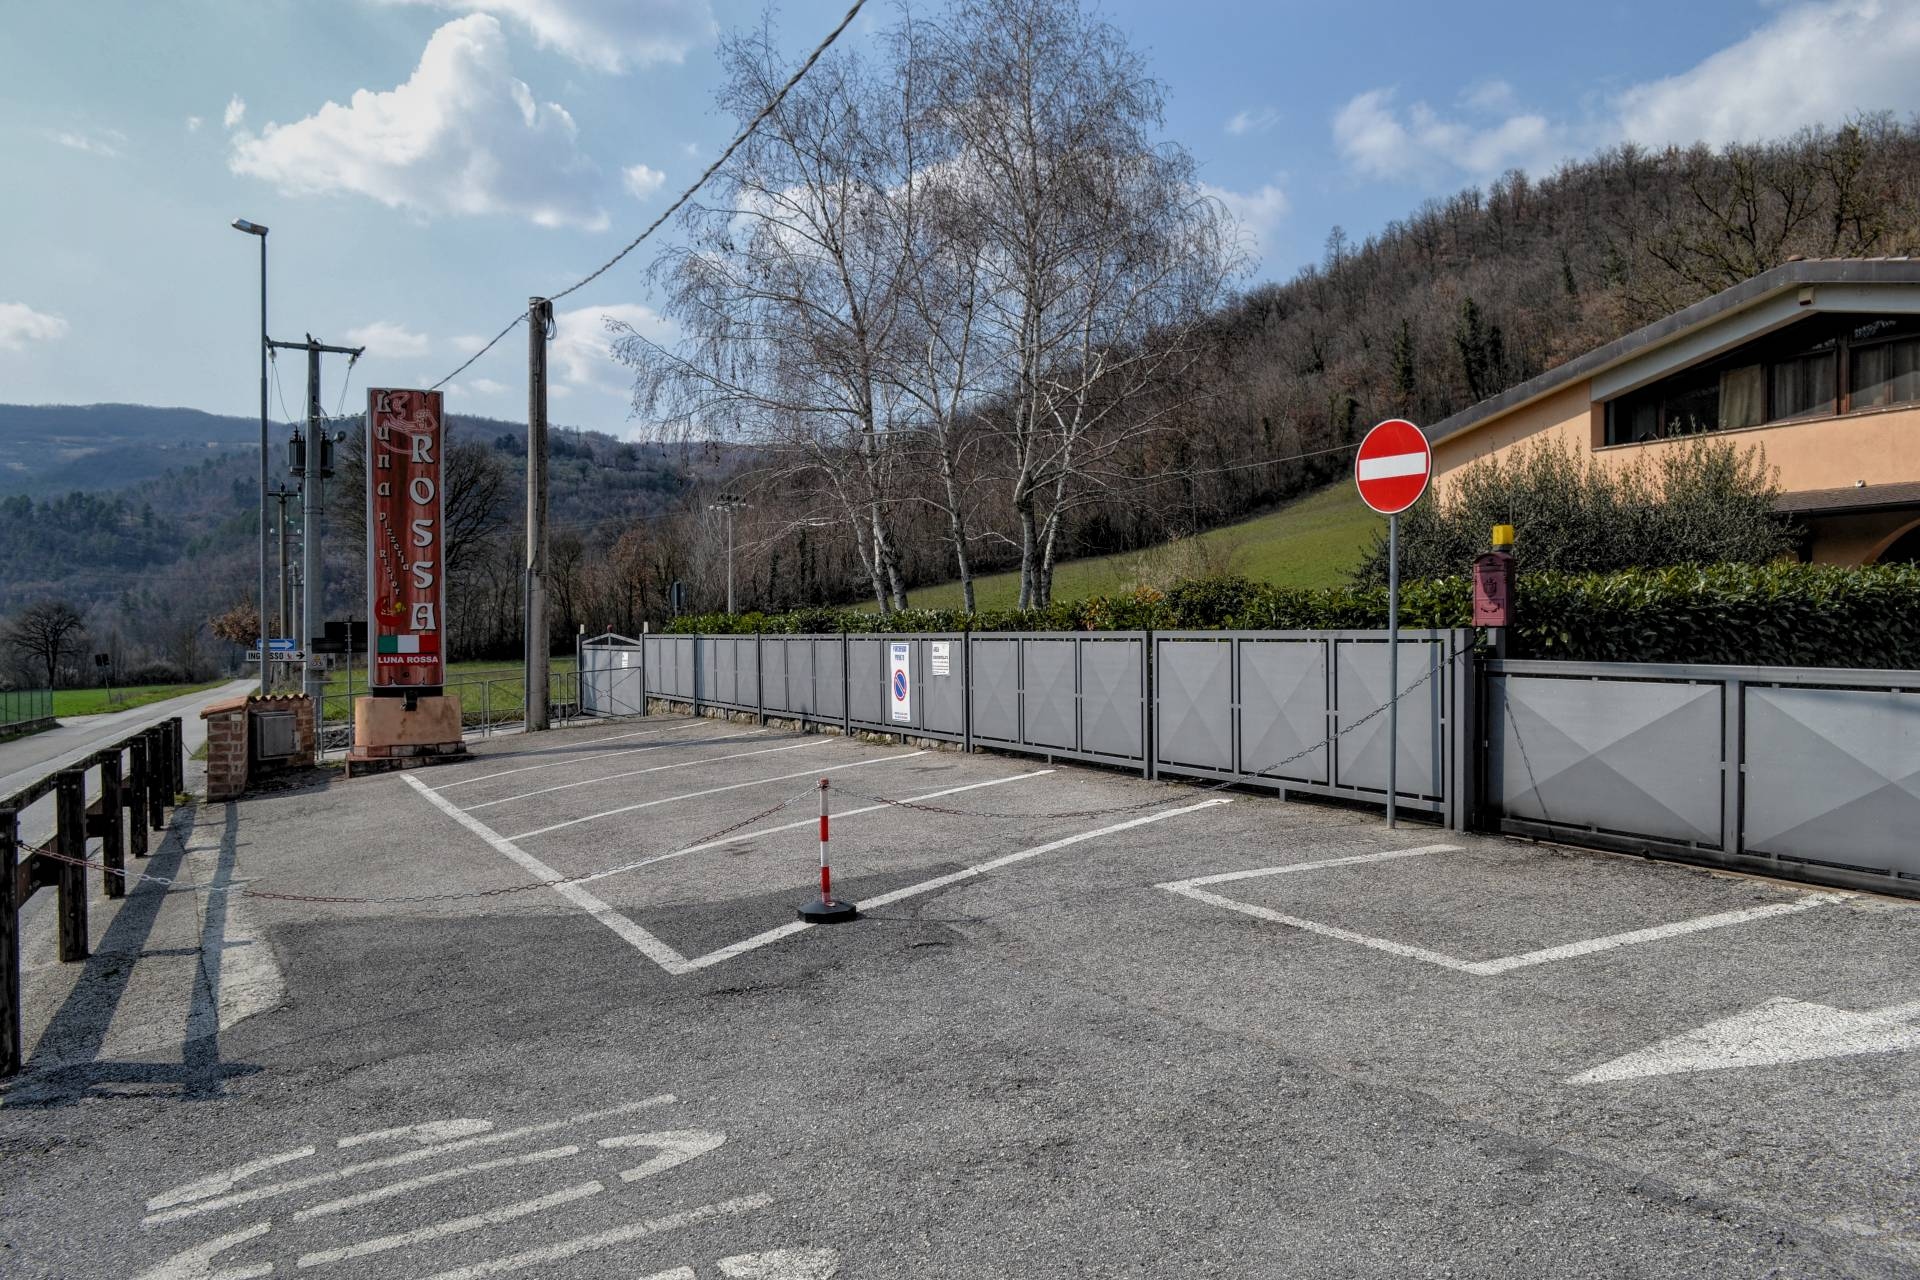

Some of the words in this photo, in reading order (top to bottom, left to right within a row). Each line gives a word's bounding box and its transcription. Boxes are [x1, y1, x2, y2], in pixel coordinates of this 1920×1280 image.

[409, 434, 436, 630] ROSSA
[248, 652, 284, 660] INGSSO
[377, 656, 405, 664] LUNA
[406, 655, 439, 664] ROSSA
